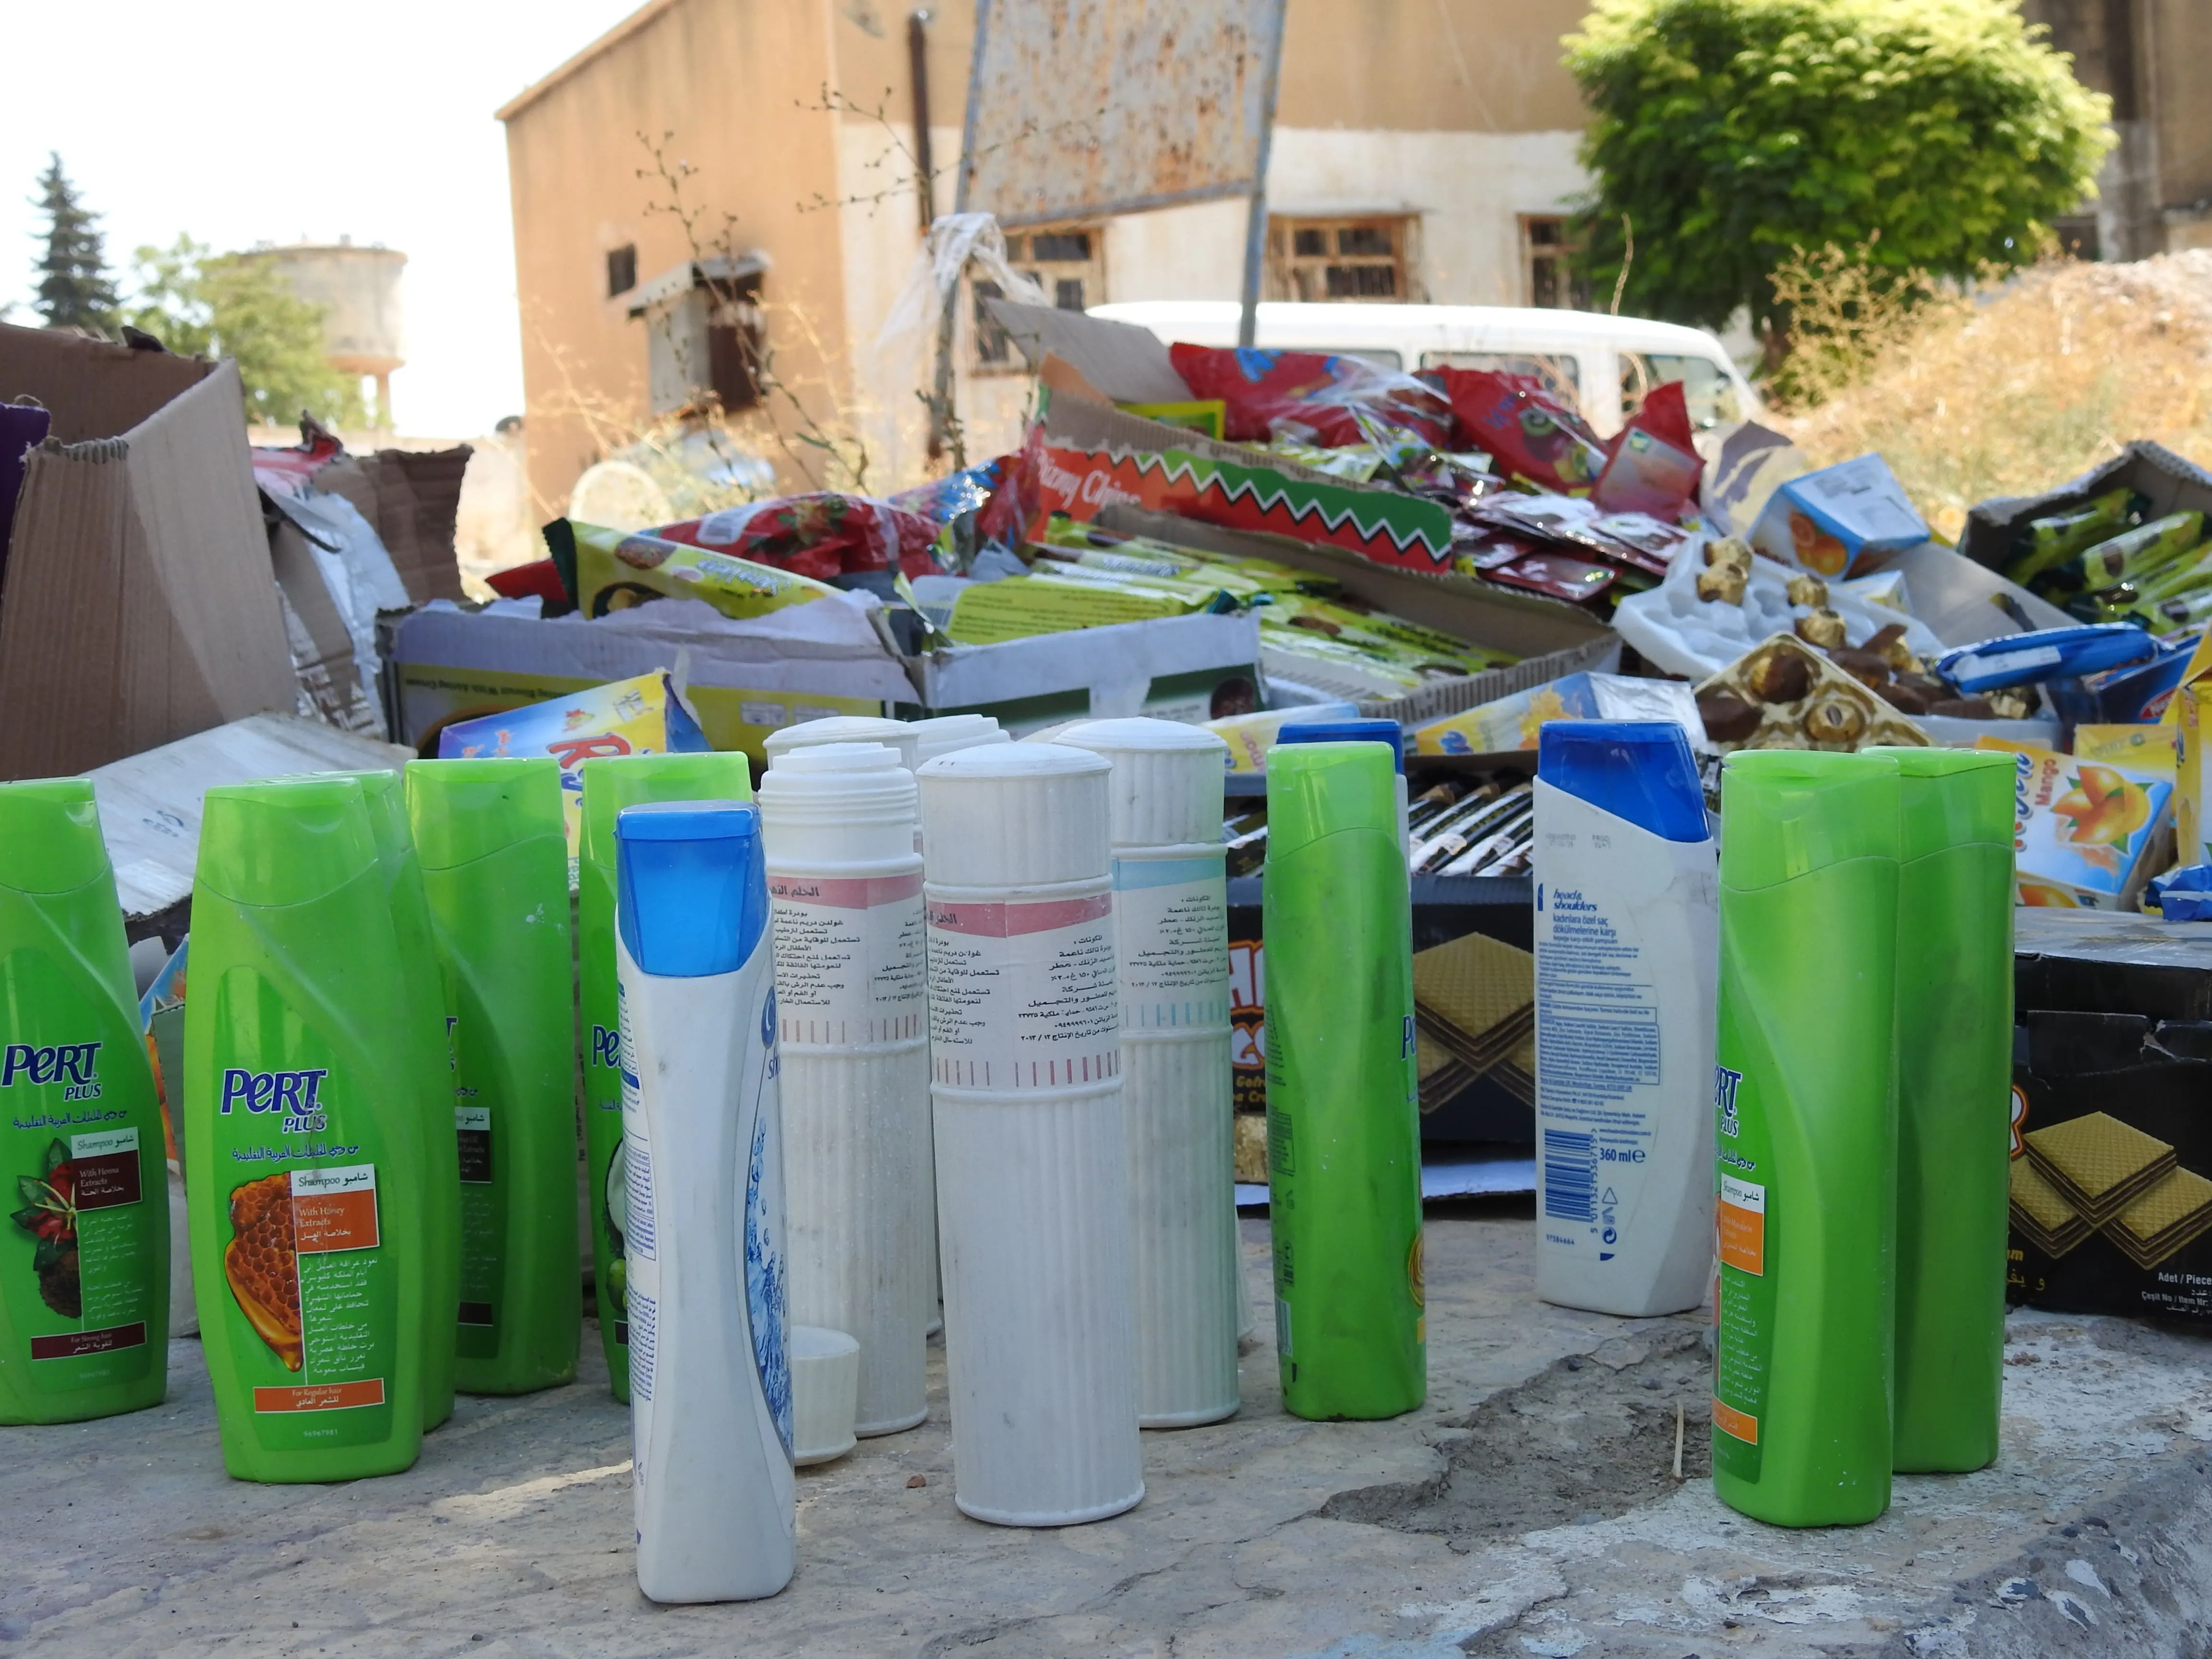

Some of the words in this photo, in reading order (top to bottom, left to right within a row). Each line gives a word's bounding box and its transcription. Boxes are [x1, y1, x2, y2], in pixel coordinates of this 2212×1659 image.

[1553, 899, 1598, 911] shoulders
[1582, 914, 1596, 925] özel
[1597, 918, 1609, 927] saç
[1079, 935, 1102, 944] المكونات
[1078, 958, 1098, 966] الزنك
[948, 968, 968, 976] للوقاية
[1062, 983, 1098, 993] شركة
[953, 997, 981, 1005] لنعومتها
[1028, 997, 1079, 1007] والتجميل
[1040, 1010, 1060, 1019] ملكية
[943, 1036, 973, 1044] للاستعمال
[1052, 1032, 1073, 1041] الإنتاج
[1075, 1030, 1092, 1039] تاريخ
[64, 1083, 102, 1102] PLUS
[12, 1114, 47, 1129] التقليدية
[48, 1112, 71, 1128] العربية
[72, 1109, 102, 1124] الخلطات
[465, 1114, 485, 1125] شامبو
[282, 1115, 327, 1133] PLUS
[1720, 1115, 1739, 1138] PLUS
[77, 1139, 113, 1150] Shampoo
[114, 1135, 134, 1148] شامبو
[232, 1146, 265, 1162] التقليدية
[267, 1144, 290, 1163] العربية
[291, 1142, 326, 1158] الخلطات
[348, 1144, 360, 1154] من
[1599, 1147, 1617, 1162] 360
[1618, 1150, 1631, 1163] ml
[80, 1168, 97, 1178] With
[98, 1167, 119, 1176] Henna
[80, 1178, 108, 1187] Extracts
[298, 1176, 341, 1189] Shampoo
[342, 1172, 368, 1187] شامبو
[101, 1186, 124, 1194] بخلاصة
[1723, 1180, 1743, 1198] Shampoo
[1743, 1190, 1759, 1202] شامبو
[299, 1206, 318, 1216] With
[320, 1206, 345, 1216] Honey
[300, 1218, 332, 1227] Extracts
[324, 1228, 351, 1237] بخلاصة
[2158, 1272, 2178, 1283] Adet
[2162, 1293, 2173, 1302] No
[2178, 1295, 2196, 1305] Item
[358, 1322, 368, 1331] من
[339, 1330, 370, 1340] التقليدية
[73, 1344, 91, 1354] الشعر
[93, 1340, 112, 1350] لتقوية
[303, 1387, 327, 1397] Regular
[296, 1398, 316, 1409] العادي
[319, 1395, 339, 1407] للشعر
